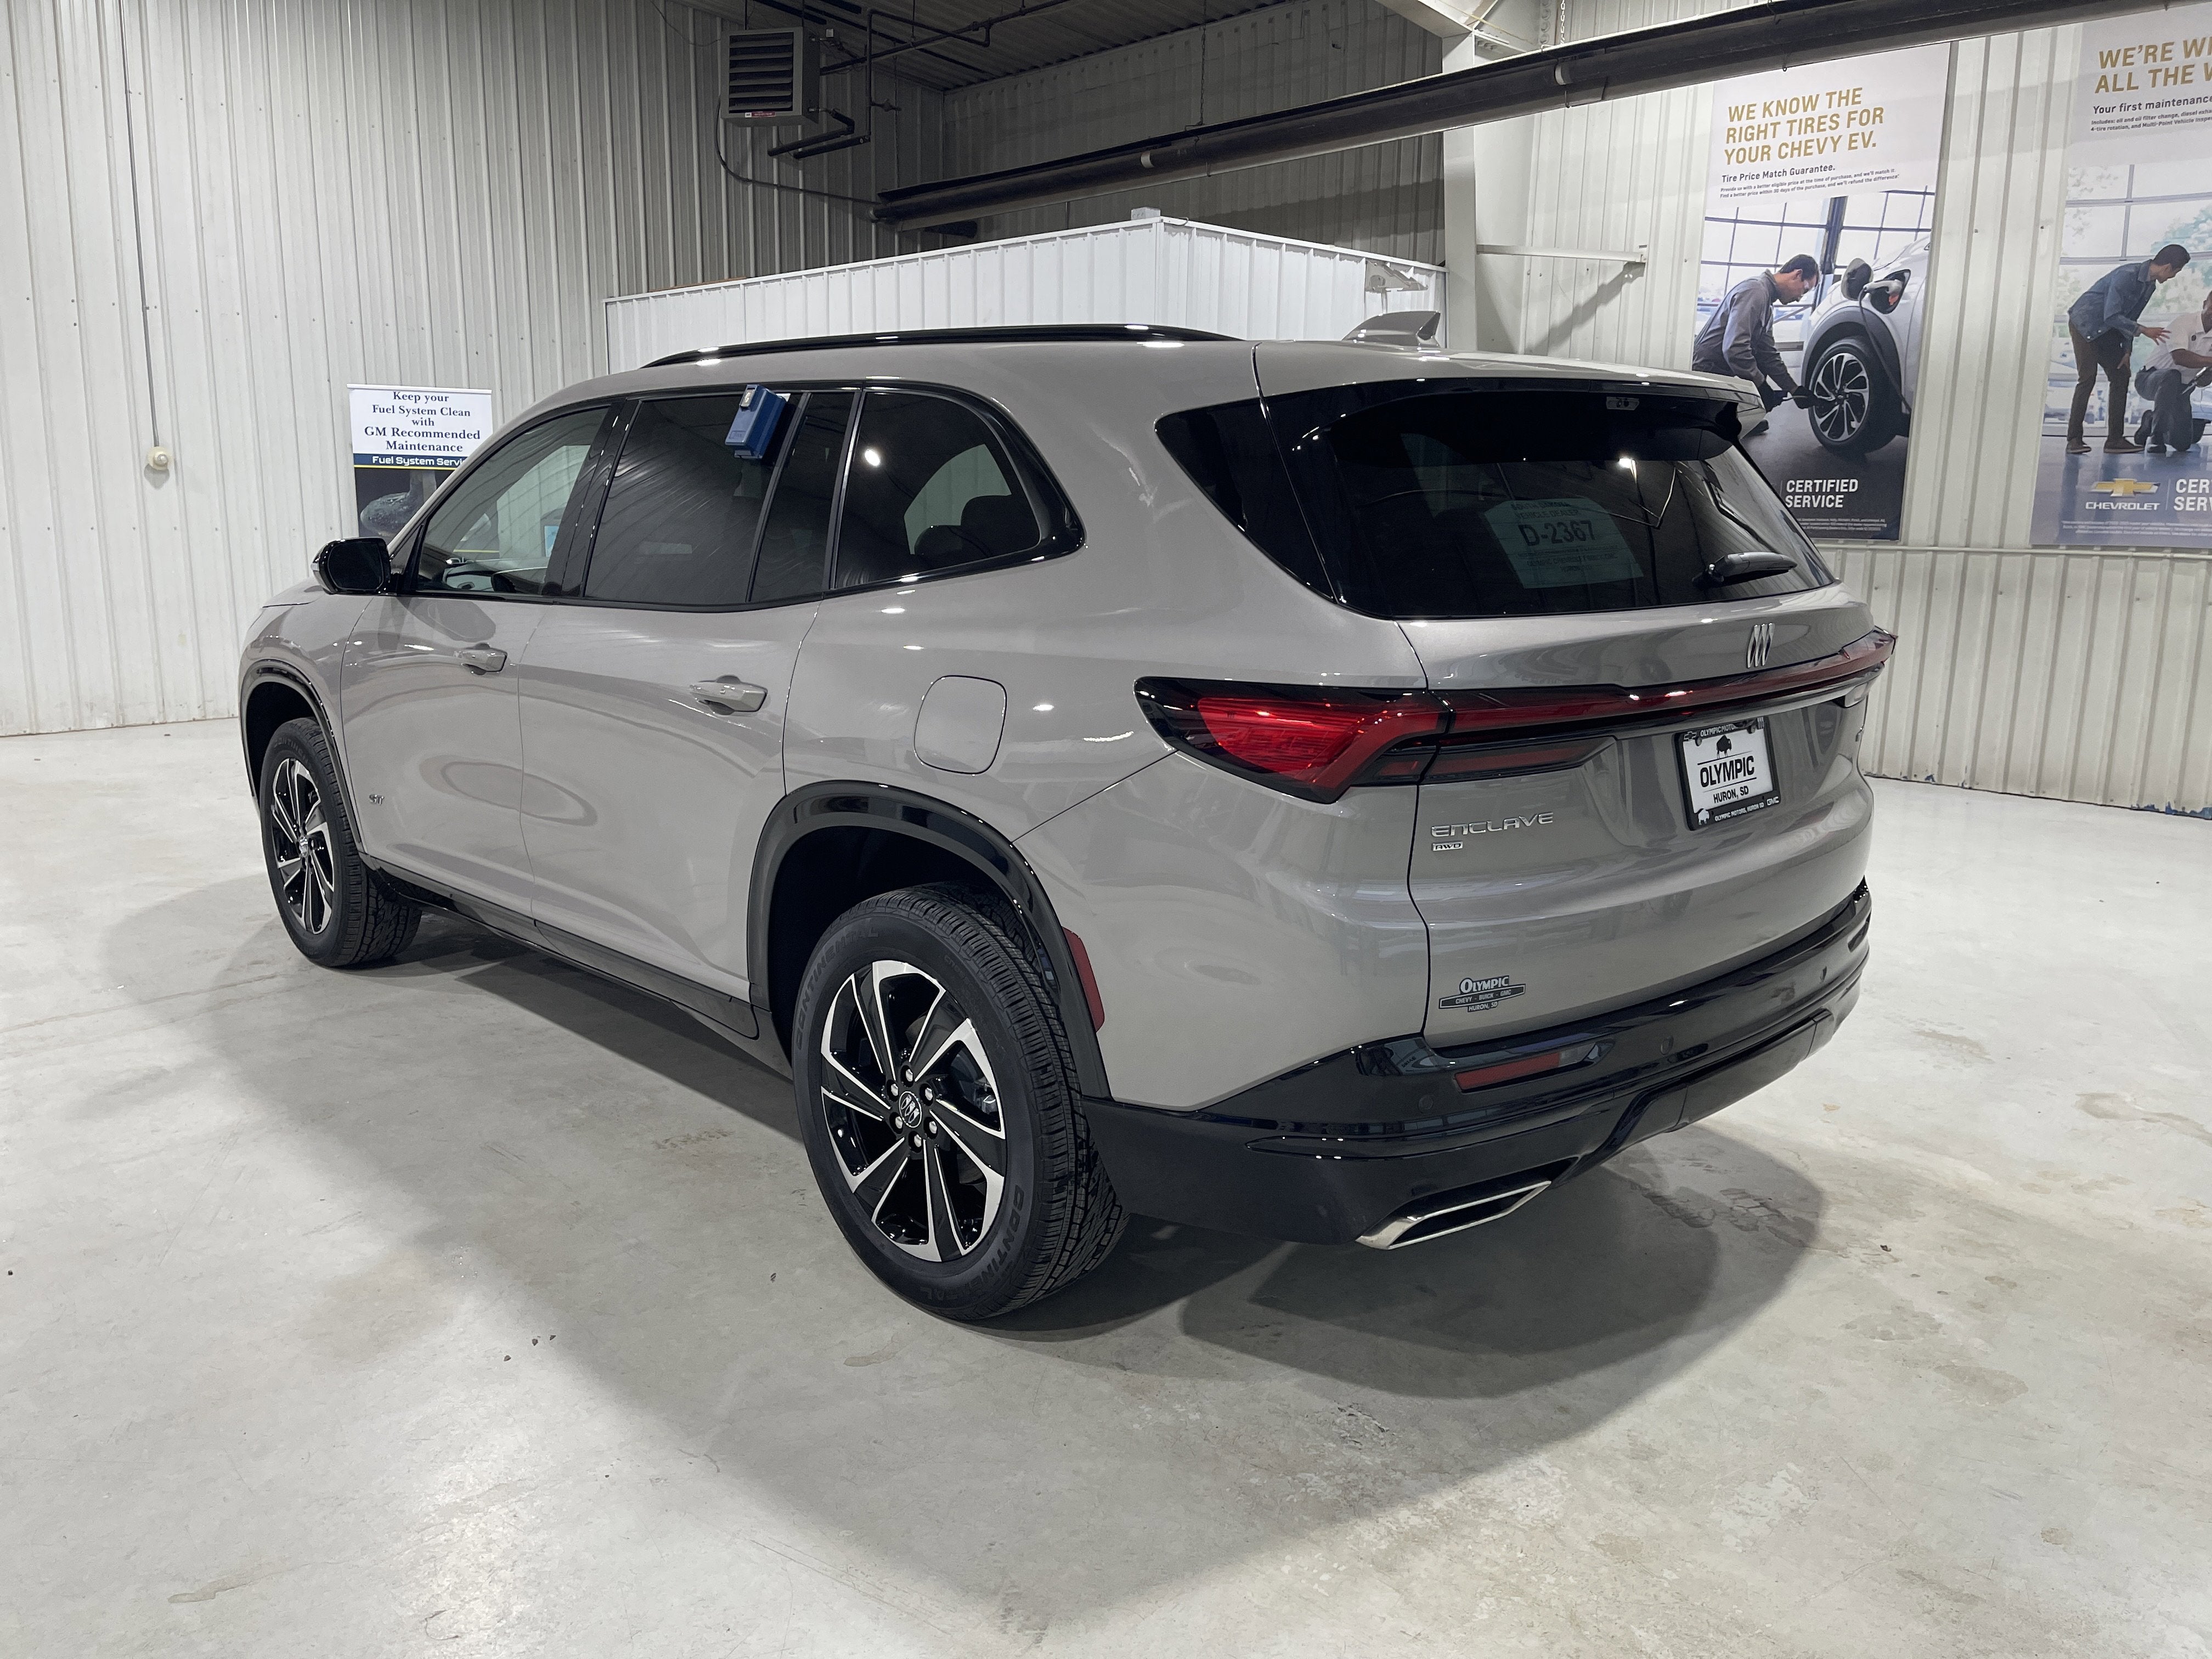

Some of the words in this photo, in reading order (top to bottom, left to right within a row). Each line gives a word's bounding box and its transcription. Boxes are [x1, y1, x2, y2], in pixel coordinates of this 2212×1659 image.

[2099, 42, 2174, 69] WE'RE
[2183, 36, 2212, 59] WI
[2095, 72, 2139, 93] ALL
[2148, 64, 2194, 88] THE
[1729, 104, 1757, 122] WE
[1762, 94, 1819, 119] KNOW
[1826, 87, 1863, 109] THE
[2093, 105, 2116, 114] Your
[2119, 101, 2142, 112] first
[1726, 122, 1781, 144] RIGHT
[1787, 114, 1840, 136] TIRES
[1847, 107, 1884, 128] FOR
[1724, 145, 1771, 165] YOUR
[1778, 135, 1843, 159] CHEVY
[1848, 131, 1877, 150] EV.
[1740, 173, 1760, 181] Price
[1762, 168, 1787, 178] Match
[1790, 165, 1836, 176] Guarantee.
[393, 391, 421, 403] Keep
[424, 395, 449, 404] your
[373, 404, 395, 414] Fuel
[399, 405, 436, 417] System
[441, 407, 471, 416] Clean
[411, 417, 435, 426] with
[364, 426, 387, 436] GM
[391, 427, 481, 439] Recommended
[386, 441, 463, 452] Maintenance
[373, 456, 394, 465] Fuel
[396, 457, 435, 466] System
[437, 458, 464, 466] Servi
[1786, 479, 1859, 493] CERTIFIED
[1785, 495, 1844, 508] SERVICE
[2085, 502, 2160, 511] CHEVROLET
[1517, 521, 1595, 546] D-2367
[1700, 726, 1722, 737] OLYMPIC
[1700, 755, 1754, 787] OLYMPIC
[1713, 788, 1739, 804] HURON,
[1740, 786, 1749, 795] SD
[1767, 796, 1779, 806] GMC
[1431, 812, 1554, 837] ENCLAVE
